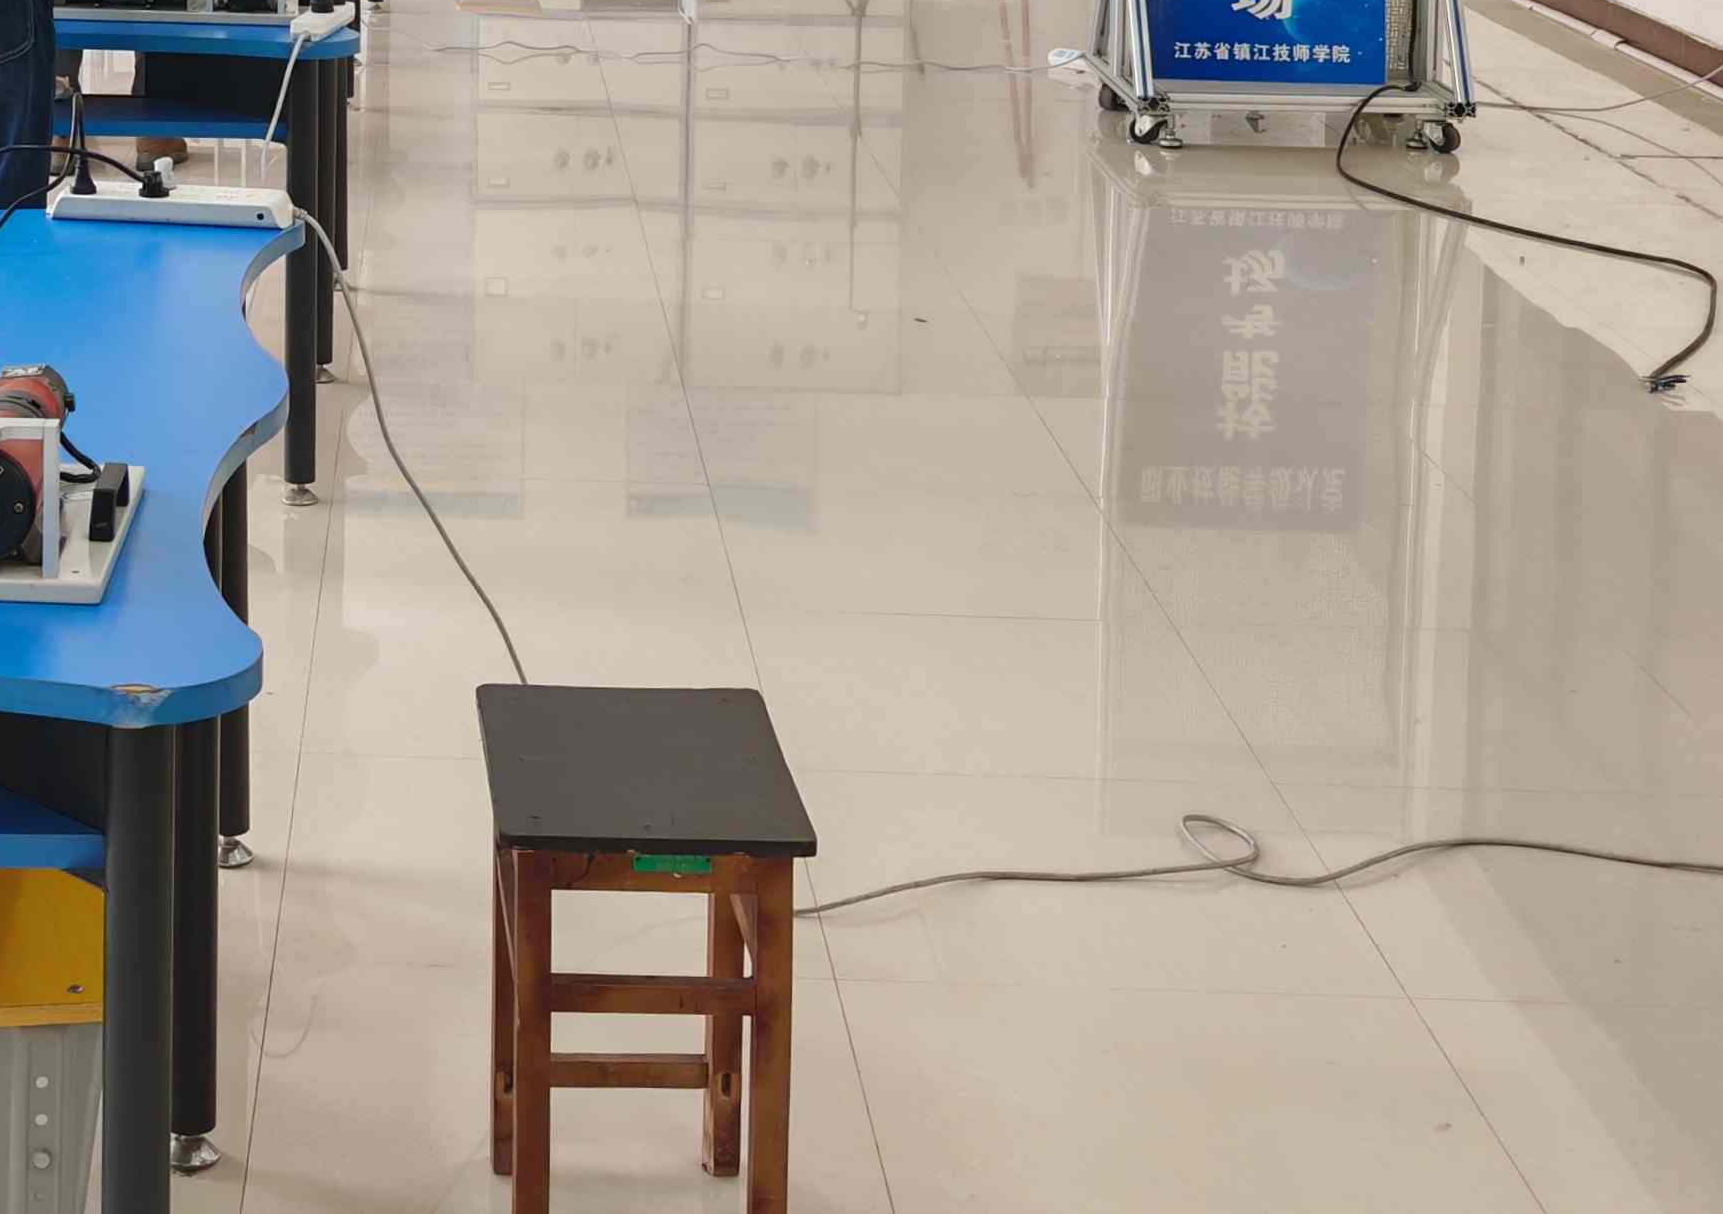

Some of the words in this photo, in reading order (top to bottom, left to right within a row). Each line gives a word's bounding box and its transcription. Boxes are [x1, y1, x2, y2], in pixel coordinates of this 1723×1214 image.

[1173, 41, 1352, 63] 江苏省镇江技师学院
